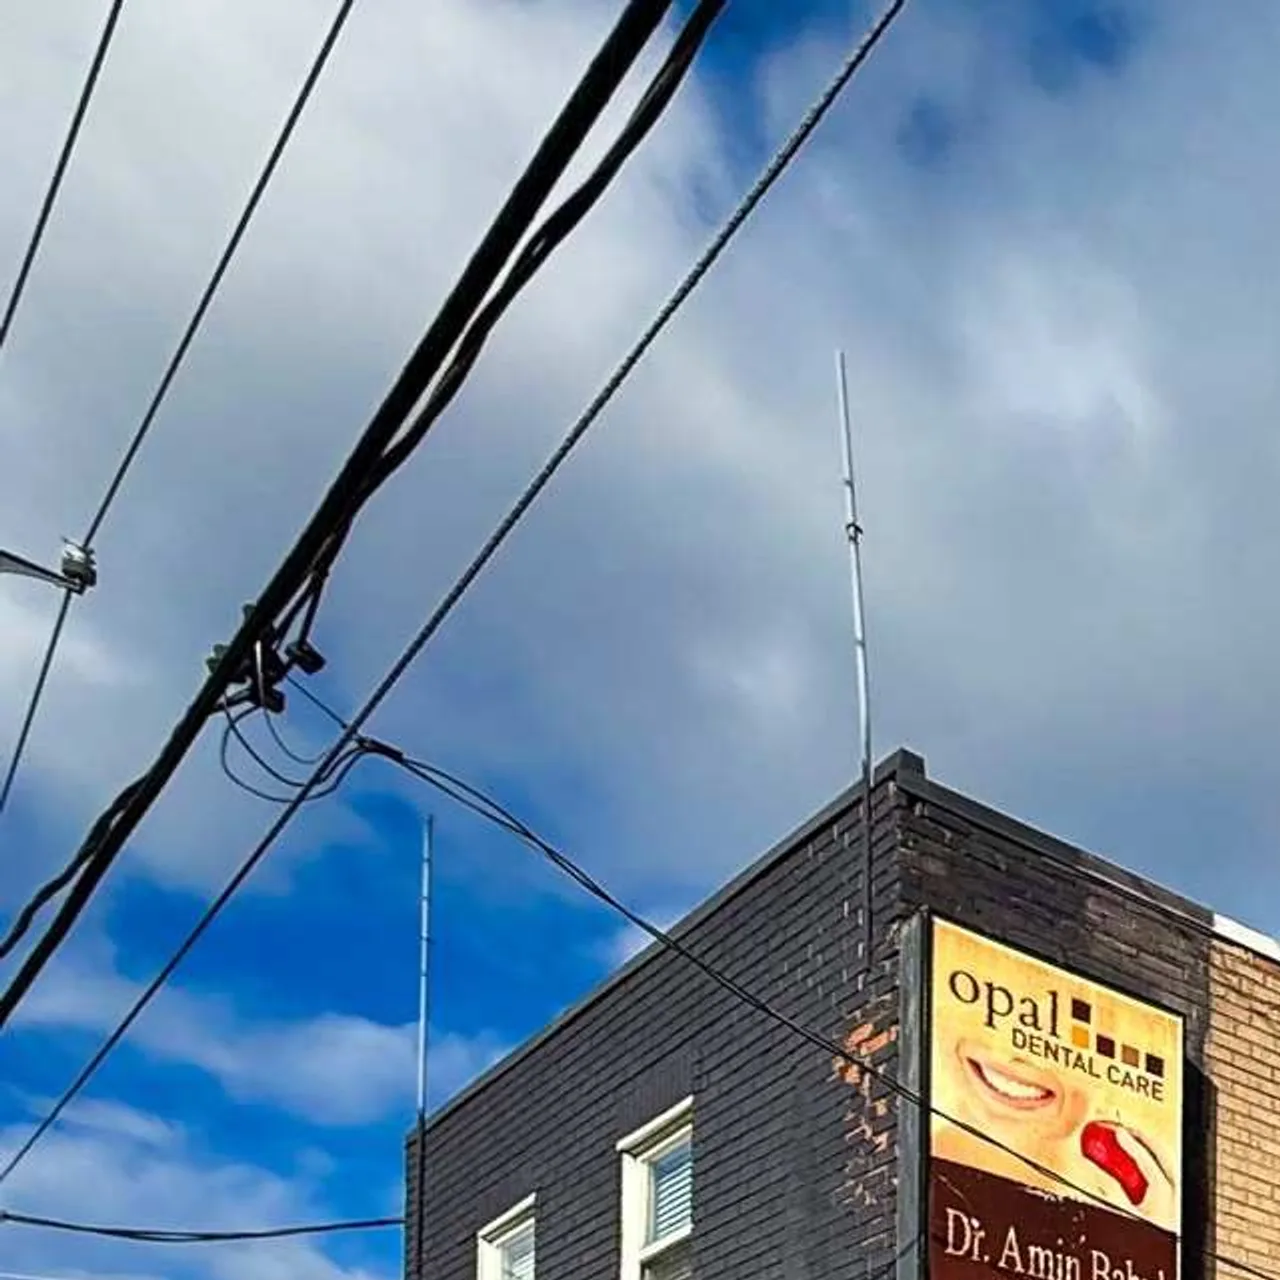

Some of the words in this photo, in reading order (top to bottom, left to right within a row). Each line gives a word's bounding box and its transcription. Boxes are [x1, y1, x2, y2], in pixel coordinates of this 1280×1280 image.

[948, 968, 1061, 1040] opal
[1011, 1027, 1100, 1079] DENTAL
[1107, 1063, 1165, 1102] CARE
[944, 1207, 990, 1264] Dr.
